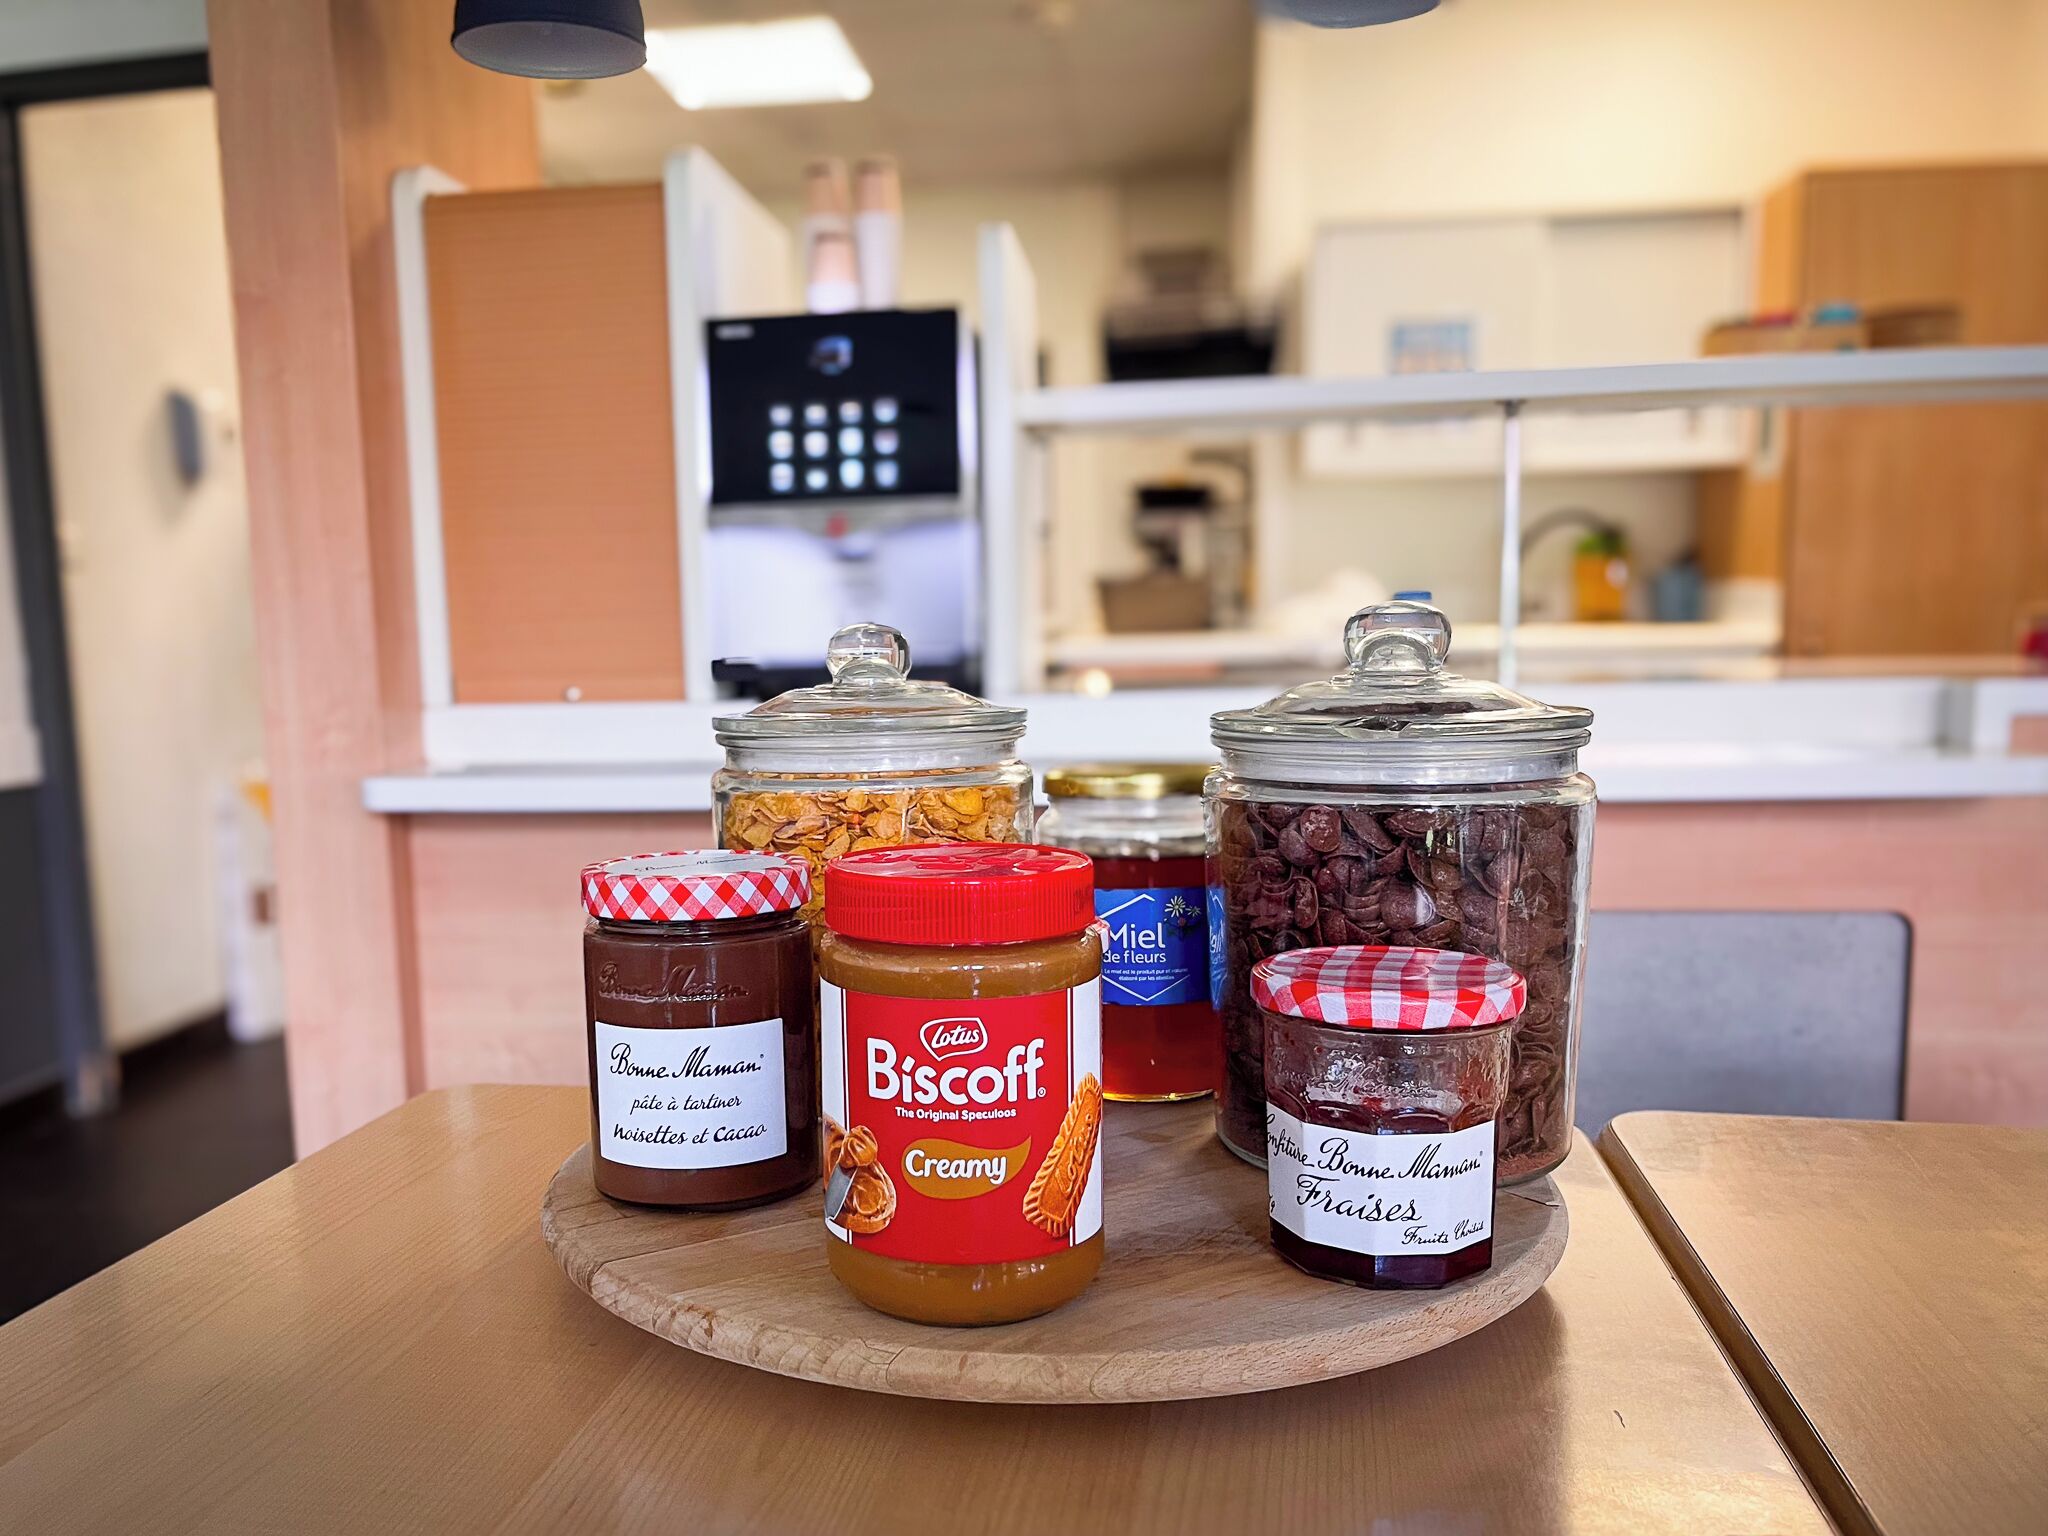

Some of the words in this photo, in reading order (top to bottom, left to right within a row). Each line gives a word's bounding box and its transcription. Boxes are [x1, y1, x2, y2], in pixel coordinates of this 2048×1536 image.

[1108, 922, 1166, 949] Miel
[1103, 950, 1120, 963] de
[1124, 950, 1167, 964] fleurs
[610, 1043, 669, 1079] Bonne
[672, 1045, 762, 1079] Maman
[867, 1037, 1045, 1105] Biscoff
[630, 1096, 663, 1115] pâte
[667, 1096, 679, 1111] à
[684, 1093, 742, 1111] tartiner
[895, 1106, 914, 1119] The
[916, 1108, 959, 1123] Original
[961, 1108, 1017, 1122] Speculoos
[692, 1128, 709, 1144] et
[905, 1149, 1007, 1185] Creamy
[1318, 1137, 1394, 1179] Bonne
[1398, 1143, 1480, 1179] Maman
[1296, 1173, 1423, 1222] Fraises
[1401, 1225, 1449, 1245] Fruits
